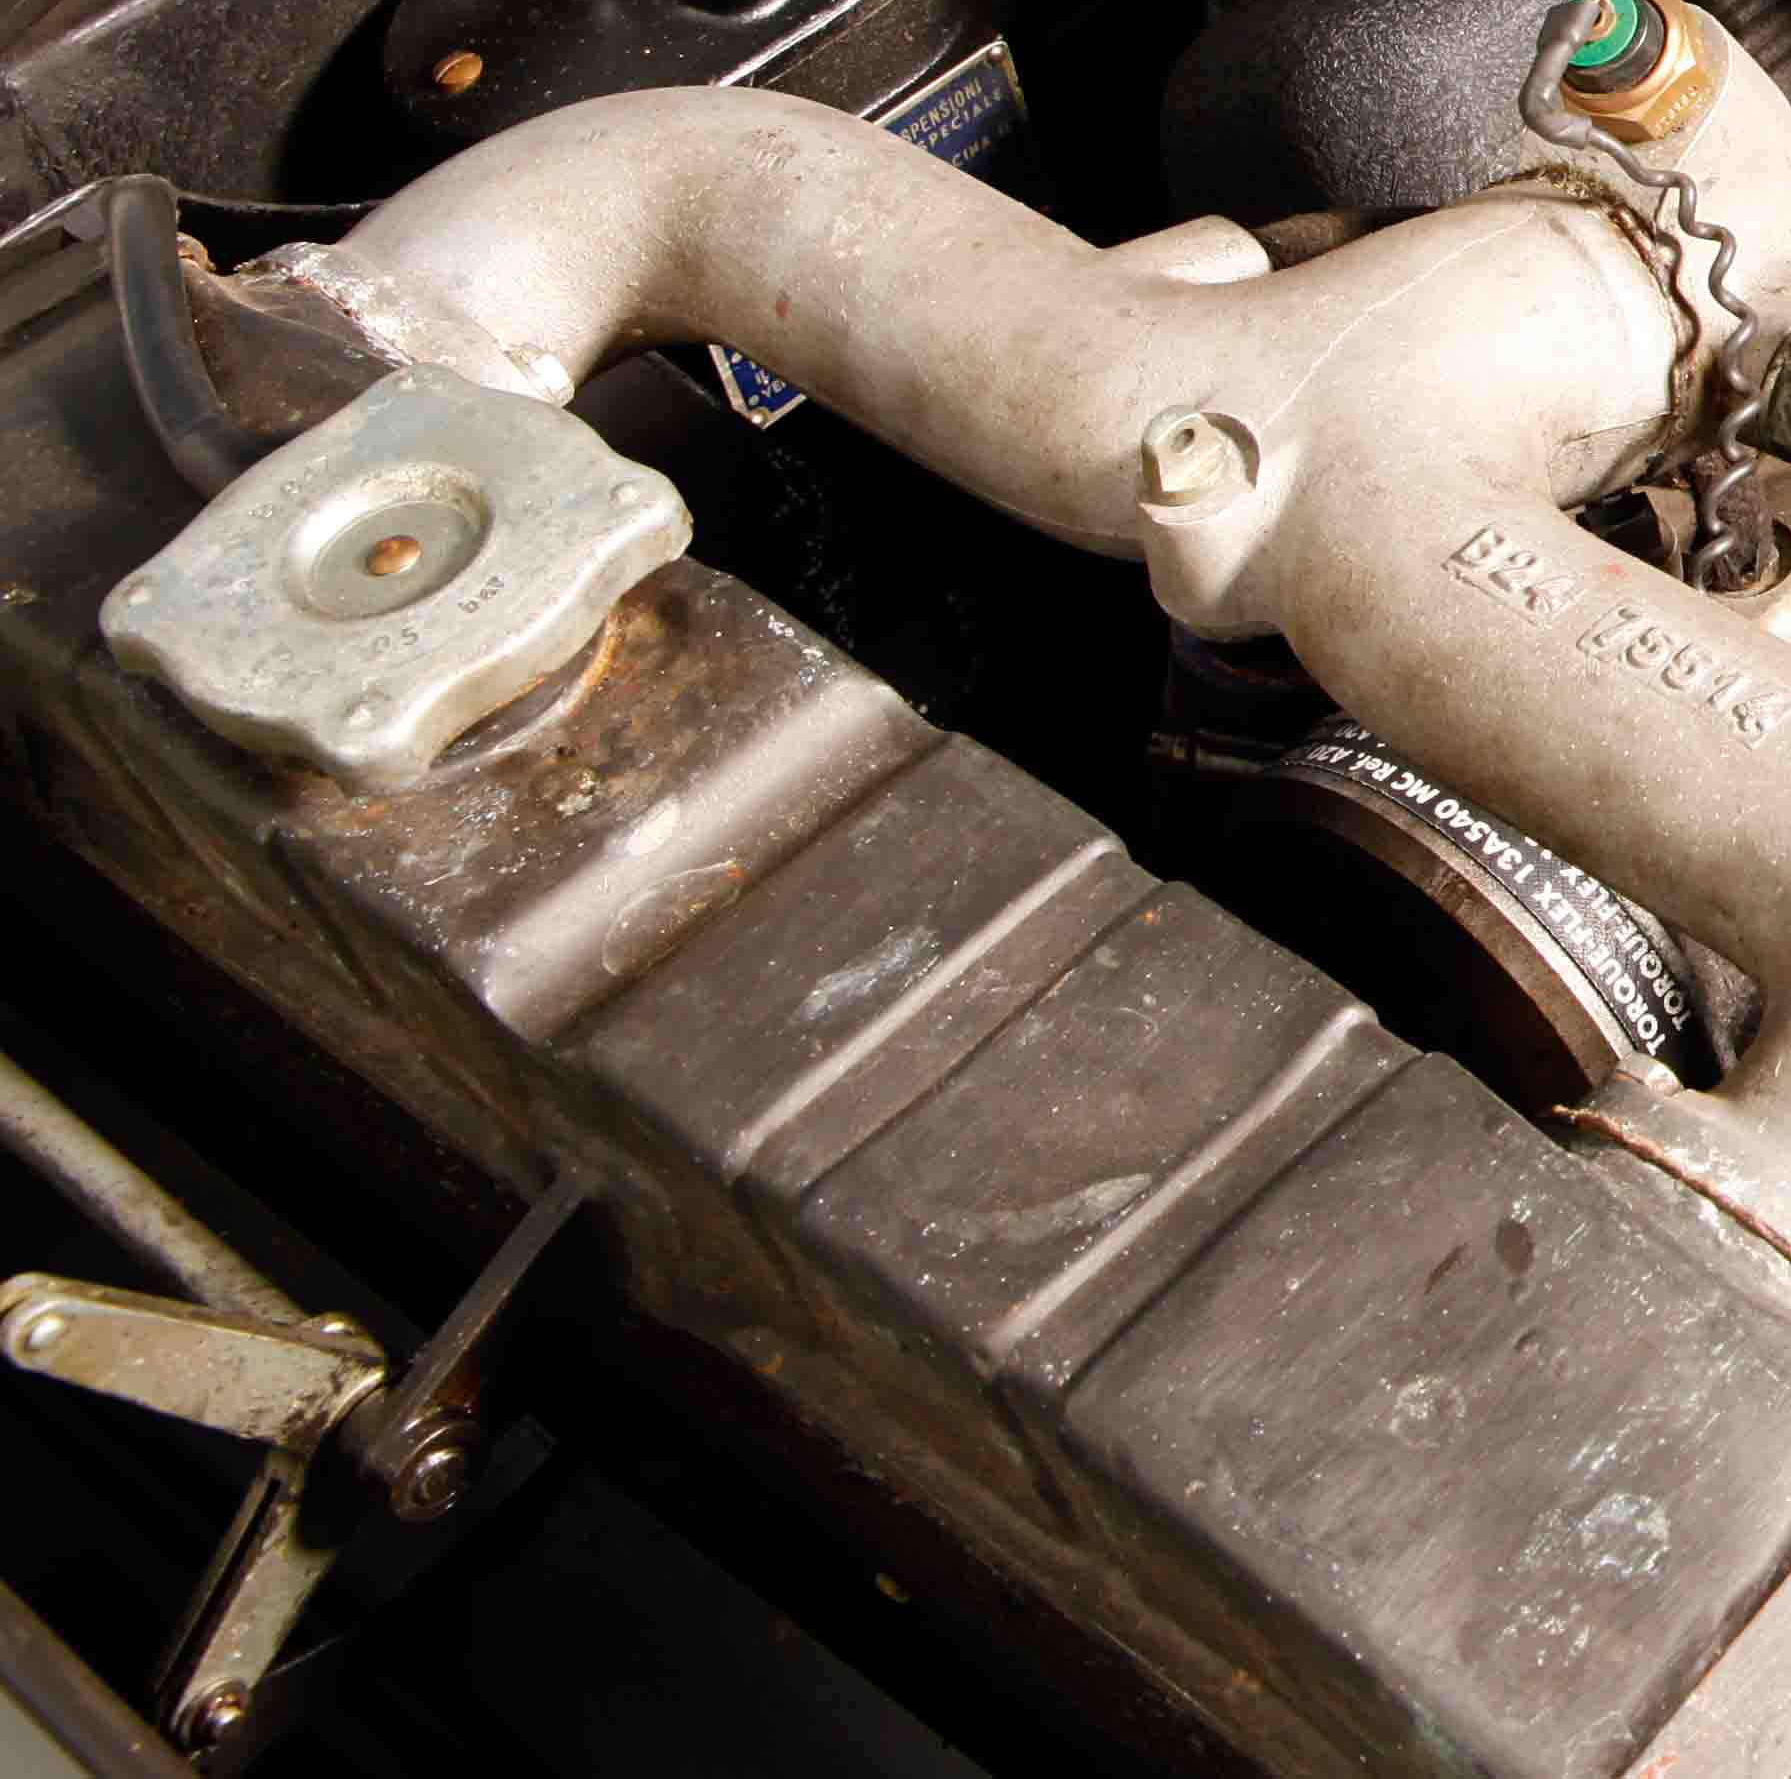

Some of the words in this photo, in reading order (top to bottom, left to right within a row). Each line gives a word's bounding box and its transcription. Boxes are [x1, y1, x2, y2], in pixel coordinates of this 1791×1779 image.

[1349, 751, 1398, 782] Ref.
[1390, 771, 1440, 804] MC
[1434, 798, 1536, 884] 13A540
[1532, 880, 1667, 1056] TORQUE-FLEX
[1560, 865, 1692, 1032] TORQUE-FLEX
